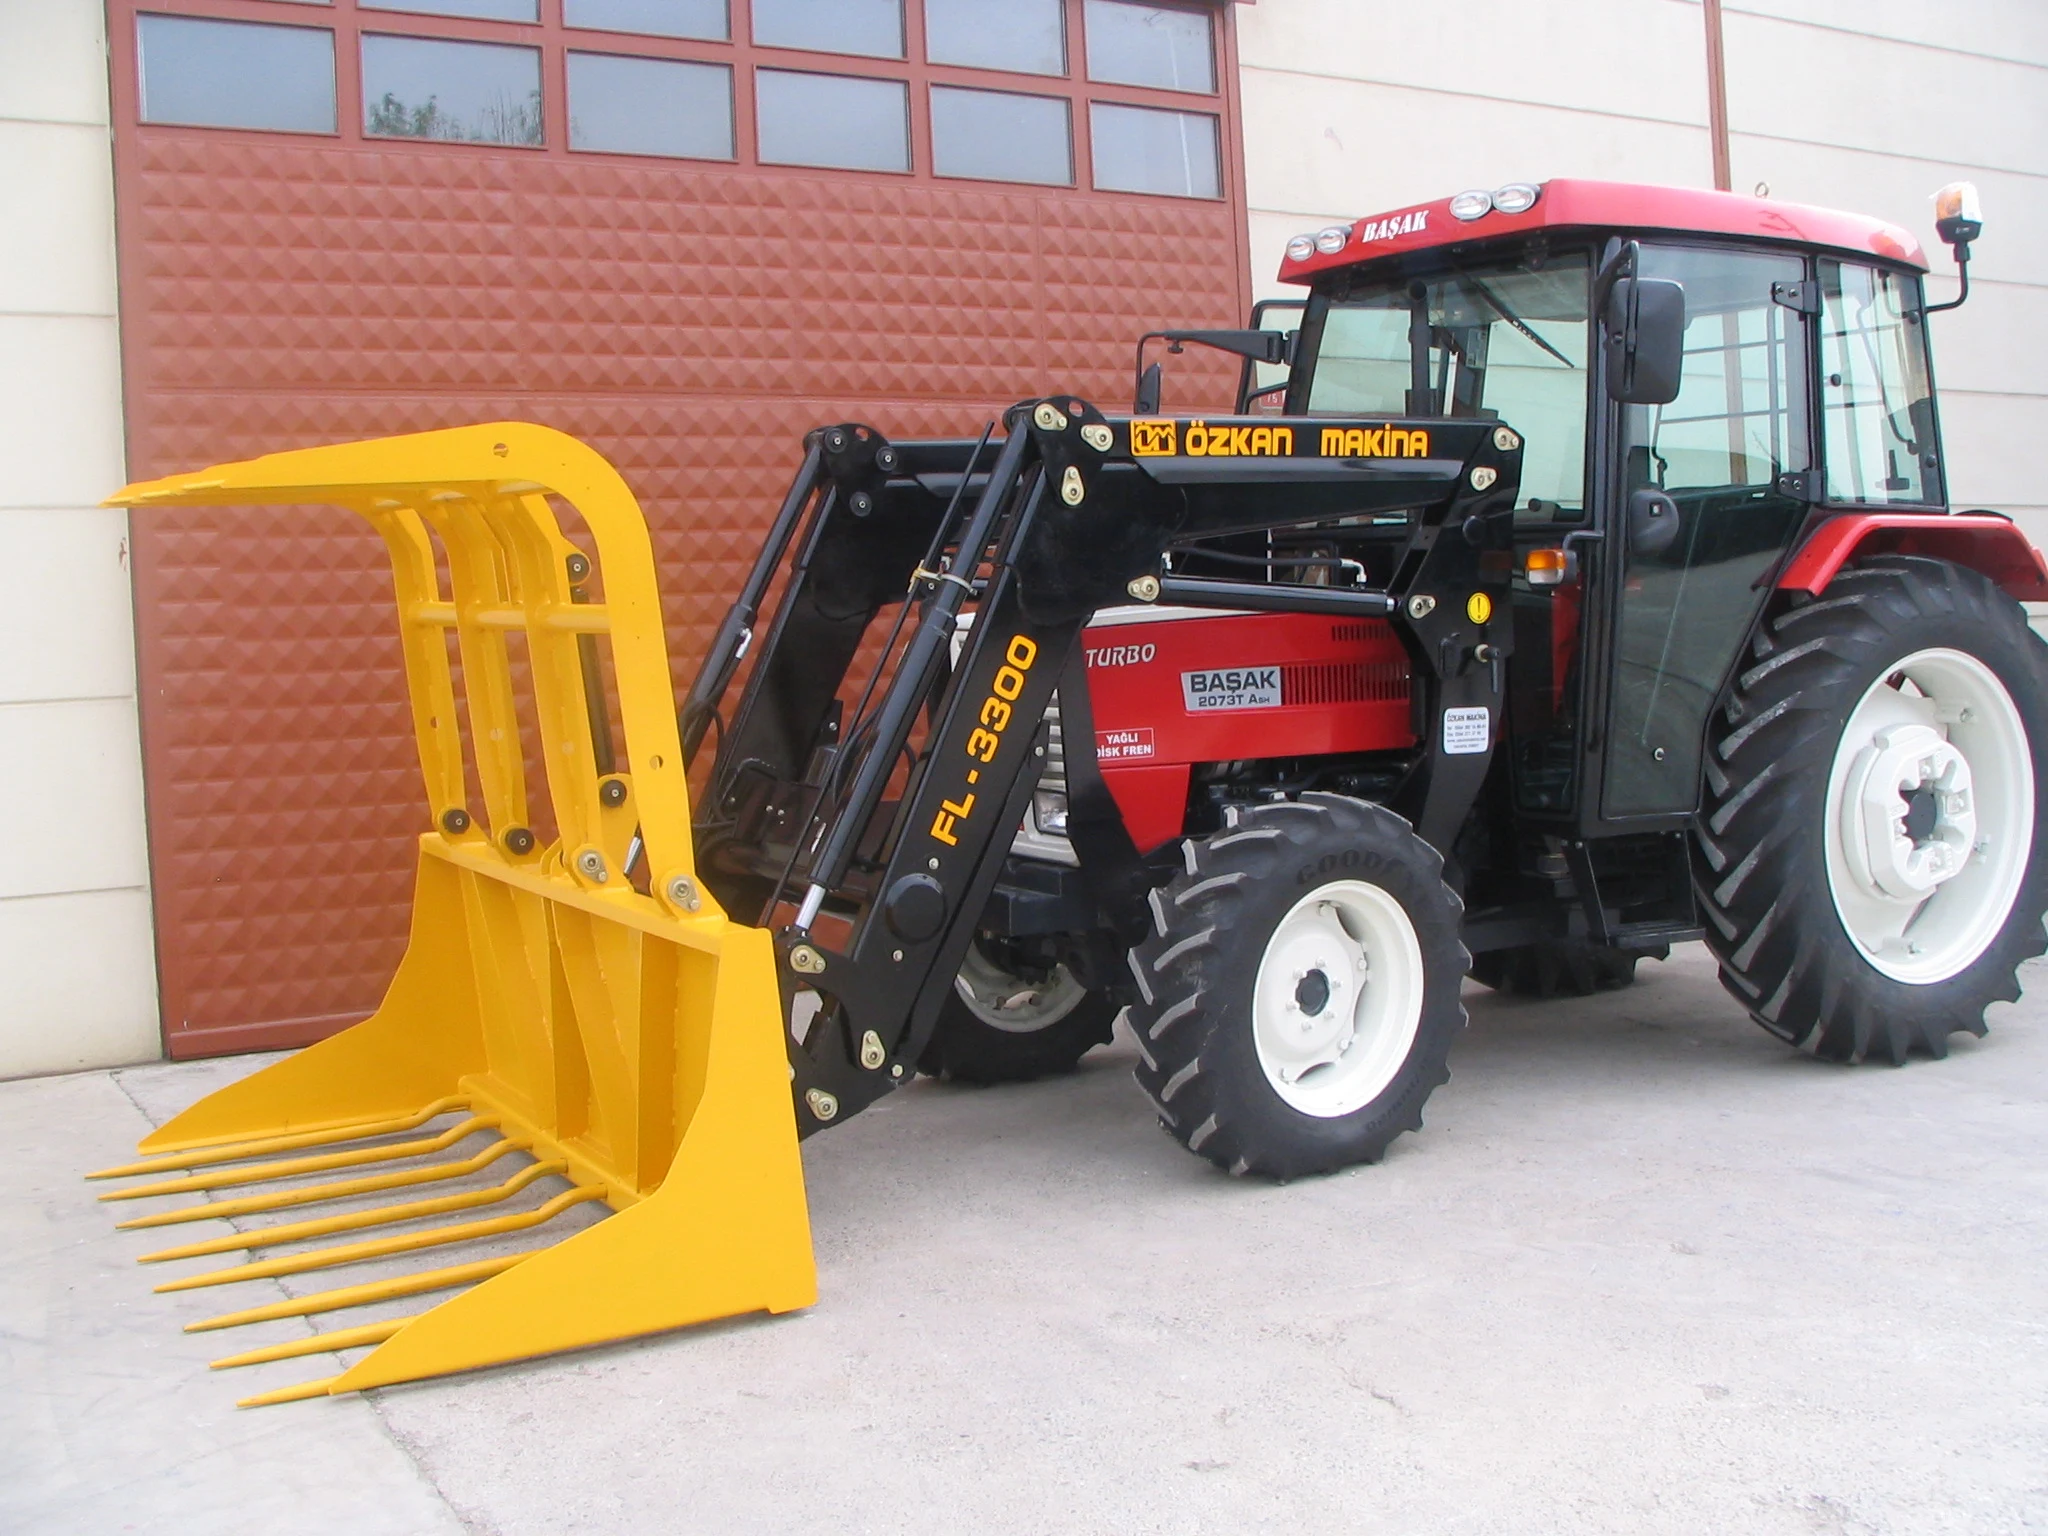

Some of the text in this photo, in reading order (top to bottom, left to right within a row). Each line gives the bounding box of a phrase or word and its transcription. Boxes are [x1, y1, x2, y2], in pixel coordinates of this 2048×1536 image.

[1362, 210, 1430, 241] BAŞAK
[1185, 420, 1293, 456] ÖZKAN
[1320, 423, 1428, 457] MAKİNA
[1086, 643, 1156, 668] TURBO
[1190, 670, 1277, 694] BAŞAK
[1198, 694, 1244, 707] 2073T
[1106, 732, 1139, 744] YAĞLI
[1122, 744, 1152, 756] FREN
